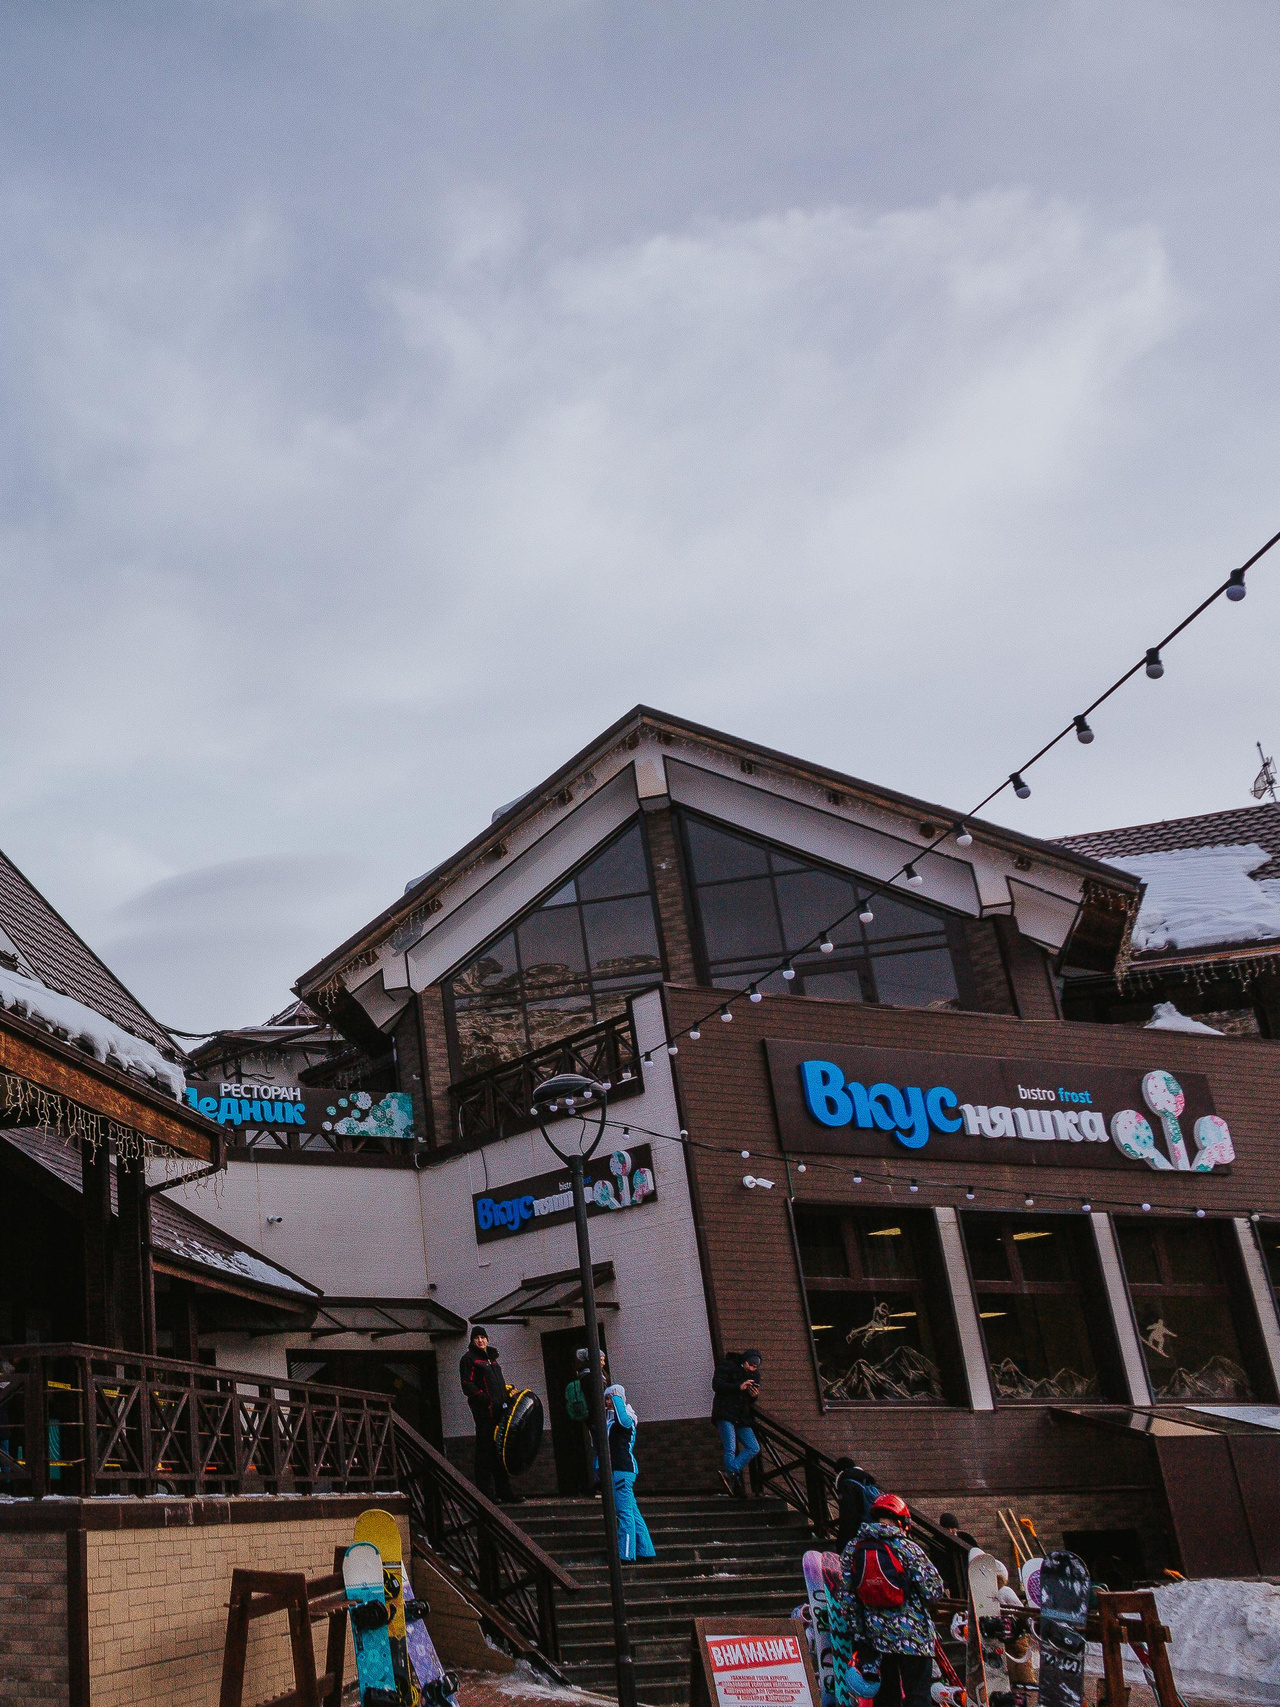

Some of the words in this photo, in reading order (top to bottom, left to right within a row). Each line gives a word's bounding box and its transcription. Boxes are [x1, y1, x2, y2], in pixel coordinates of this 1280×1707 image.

[220, 1083, 301, 1100] РЕСТОРАН
[1018, 1084, 1056, 1101] bistro
[1058, 1087, 1093, 1104] frost
[477, 1186, 596, 1230] Вкусняша
[710, 1638, 799, 1667] ВНИМАНИЕ
